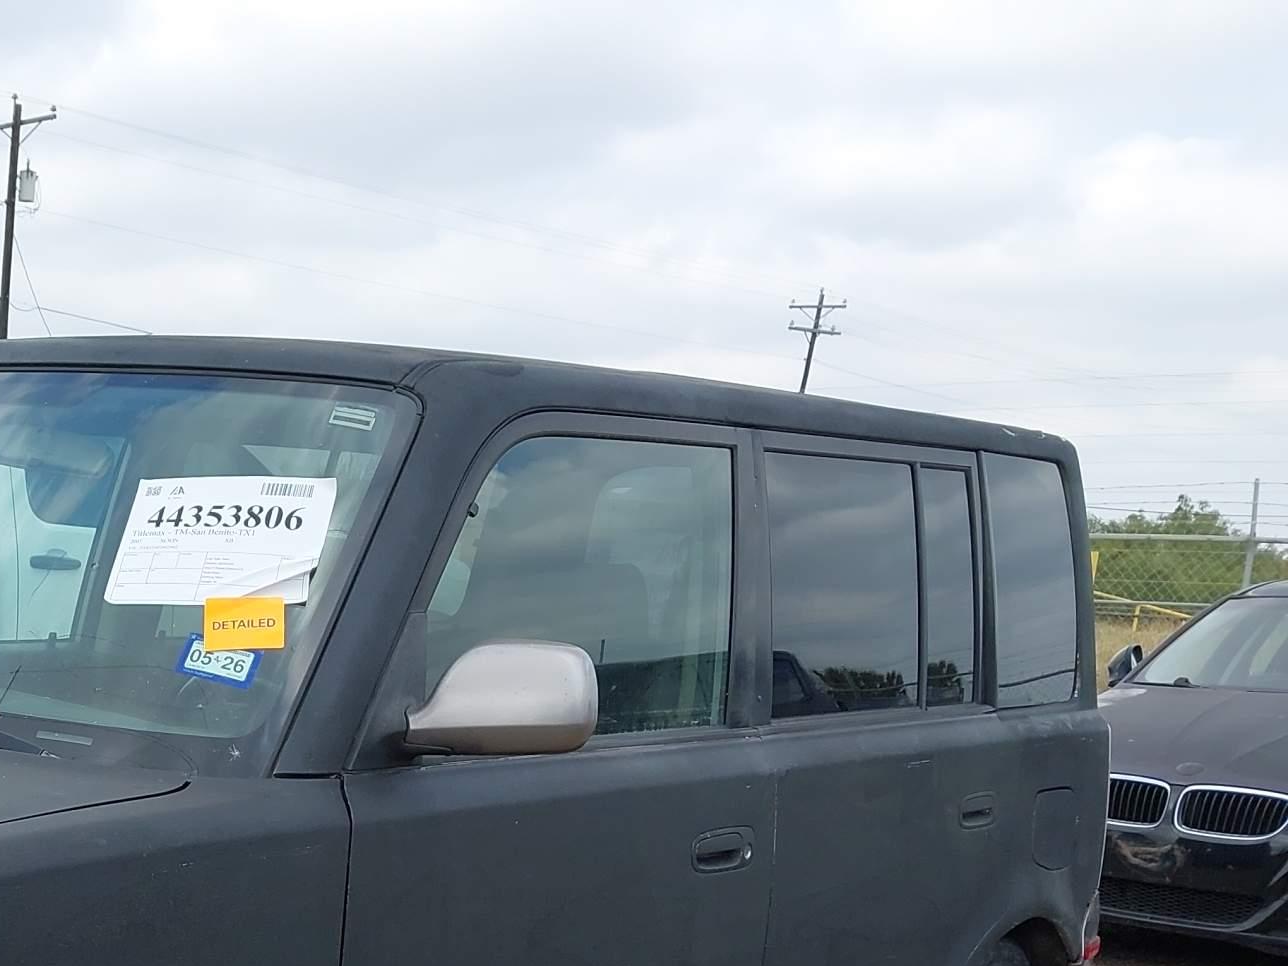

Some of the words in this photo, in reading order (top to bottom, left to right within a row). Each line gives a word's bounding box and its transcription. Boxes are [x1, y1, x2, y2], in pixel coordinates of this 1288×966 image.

[147, 504, 306, 531] 44353806
[212, 618, 276, 630] DETAILED
[189, 649, 214, 665] 05
[220, 656, 246, 673] 26
